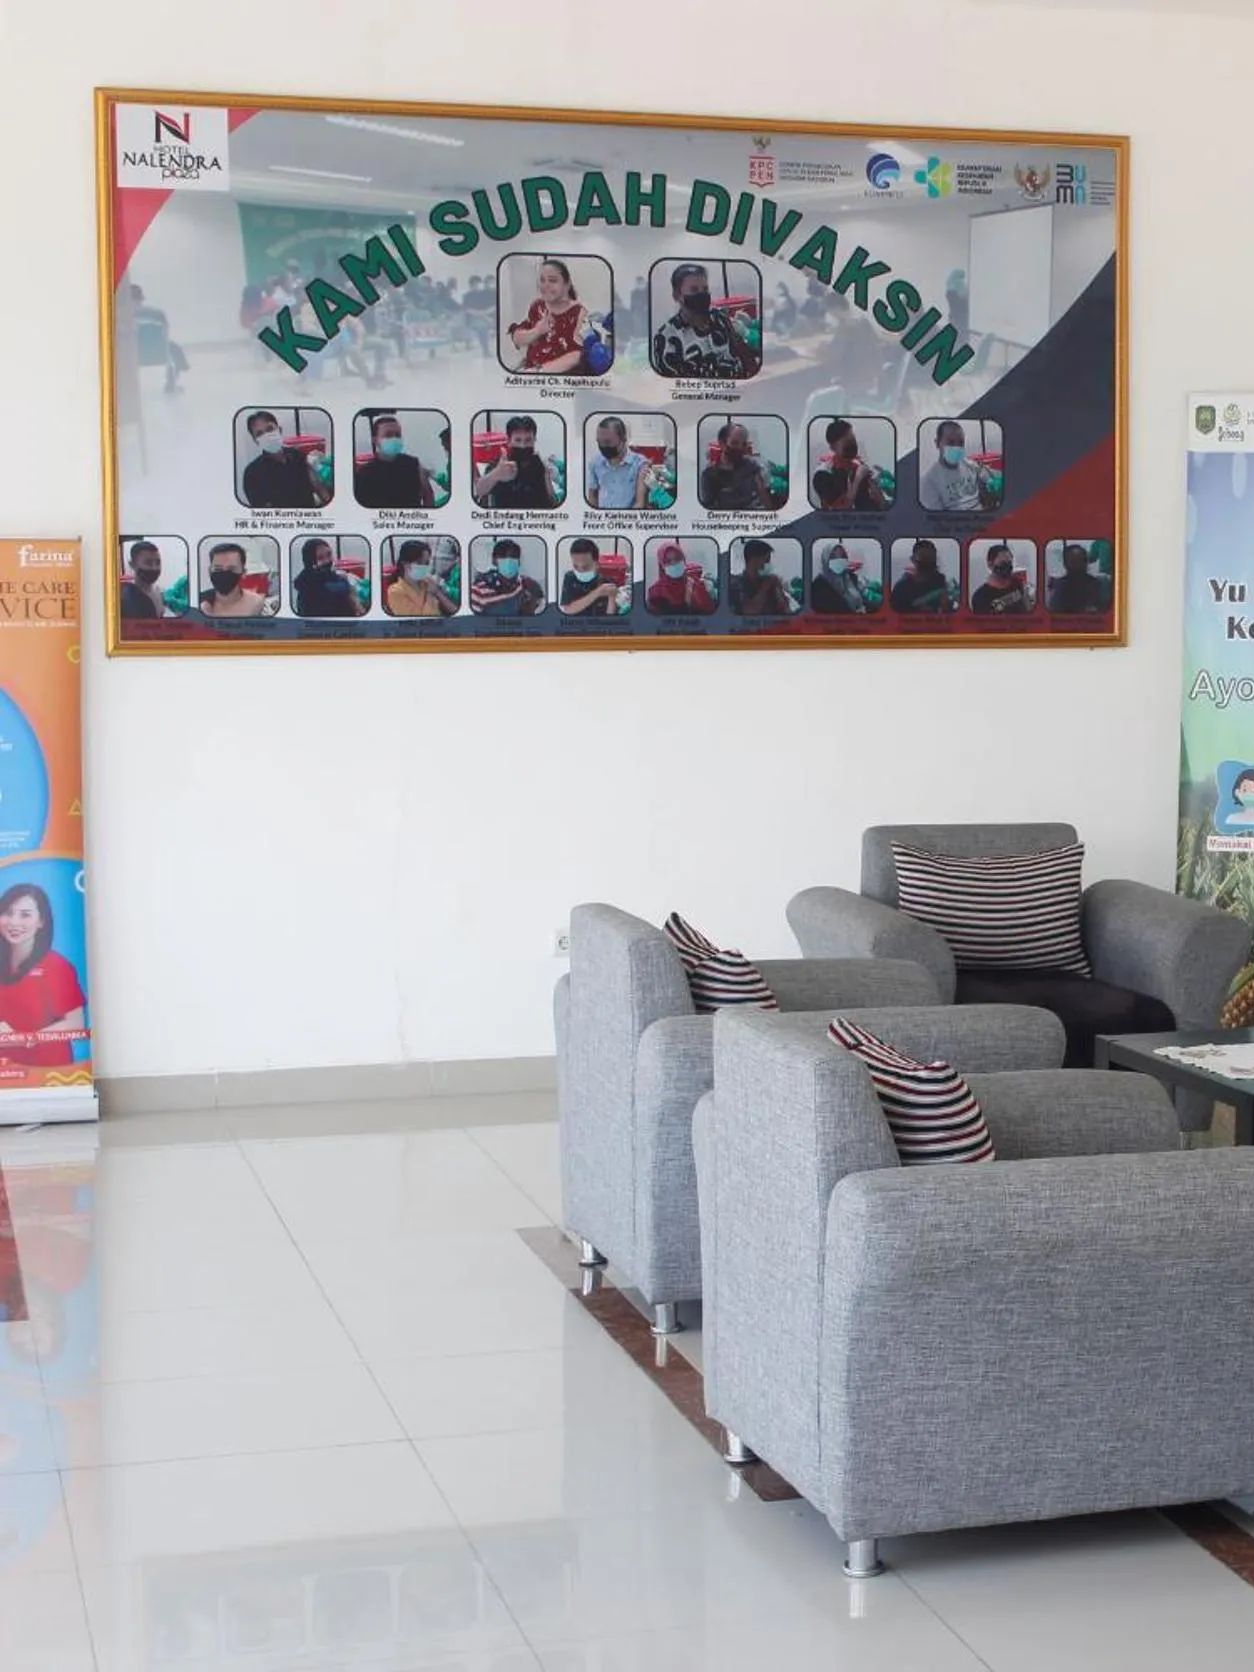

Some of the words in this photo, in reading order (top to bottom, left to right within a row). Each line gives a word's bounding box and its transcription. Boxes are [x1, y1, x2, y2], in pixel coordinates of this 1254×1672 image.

[122, 151, 223, 171] NALENDRA
[258, 223, 427, 374] KAMI
[428, 171, 667, 258] SUDAH
[685, 179, 976, 387] DIVAKSIN
[540, 389, 575, 399] Director
[671, 391, 704, 401] General
[705, 392, 742, 403] Manager
[22, 581, 77, 595] CARE
[1208, 578, 1246, 603] Yu
